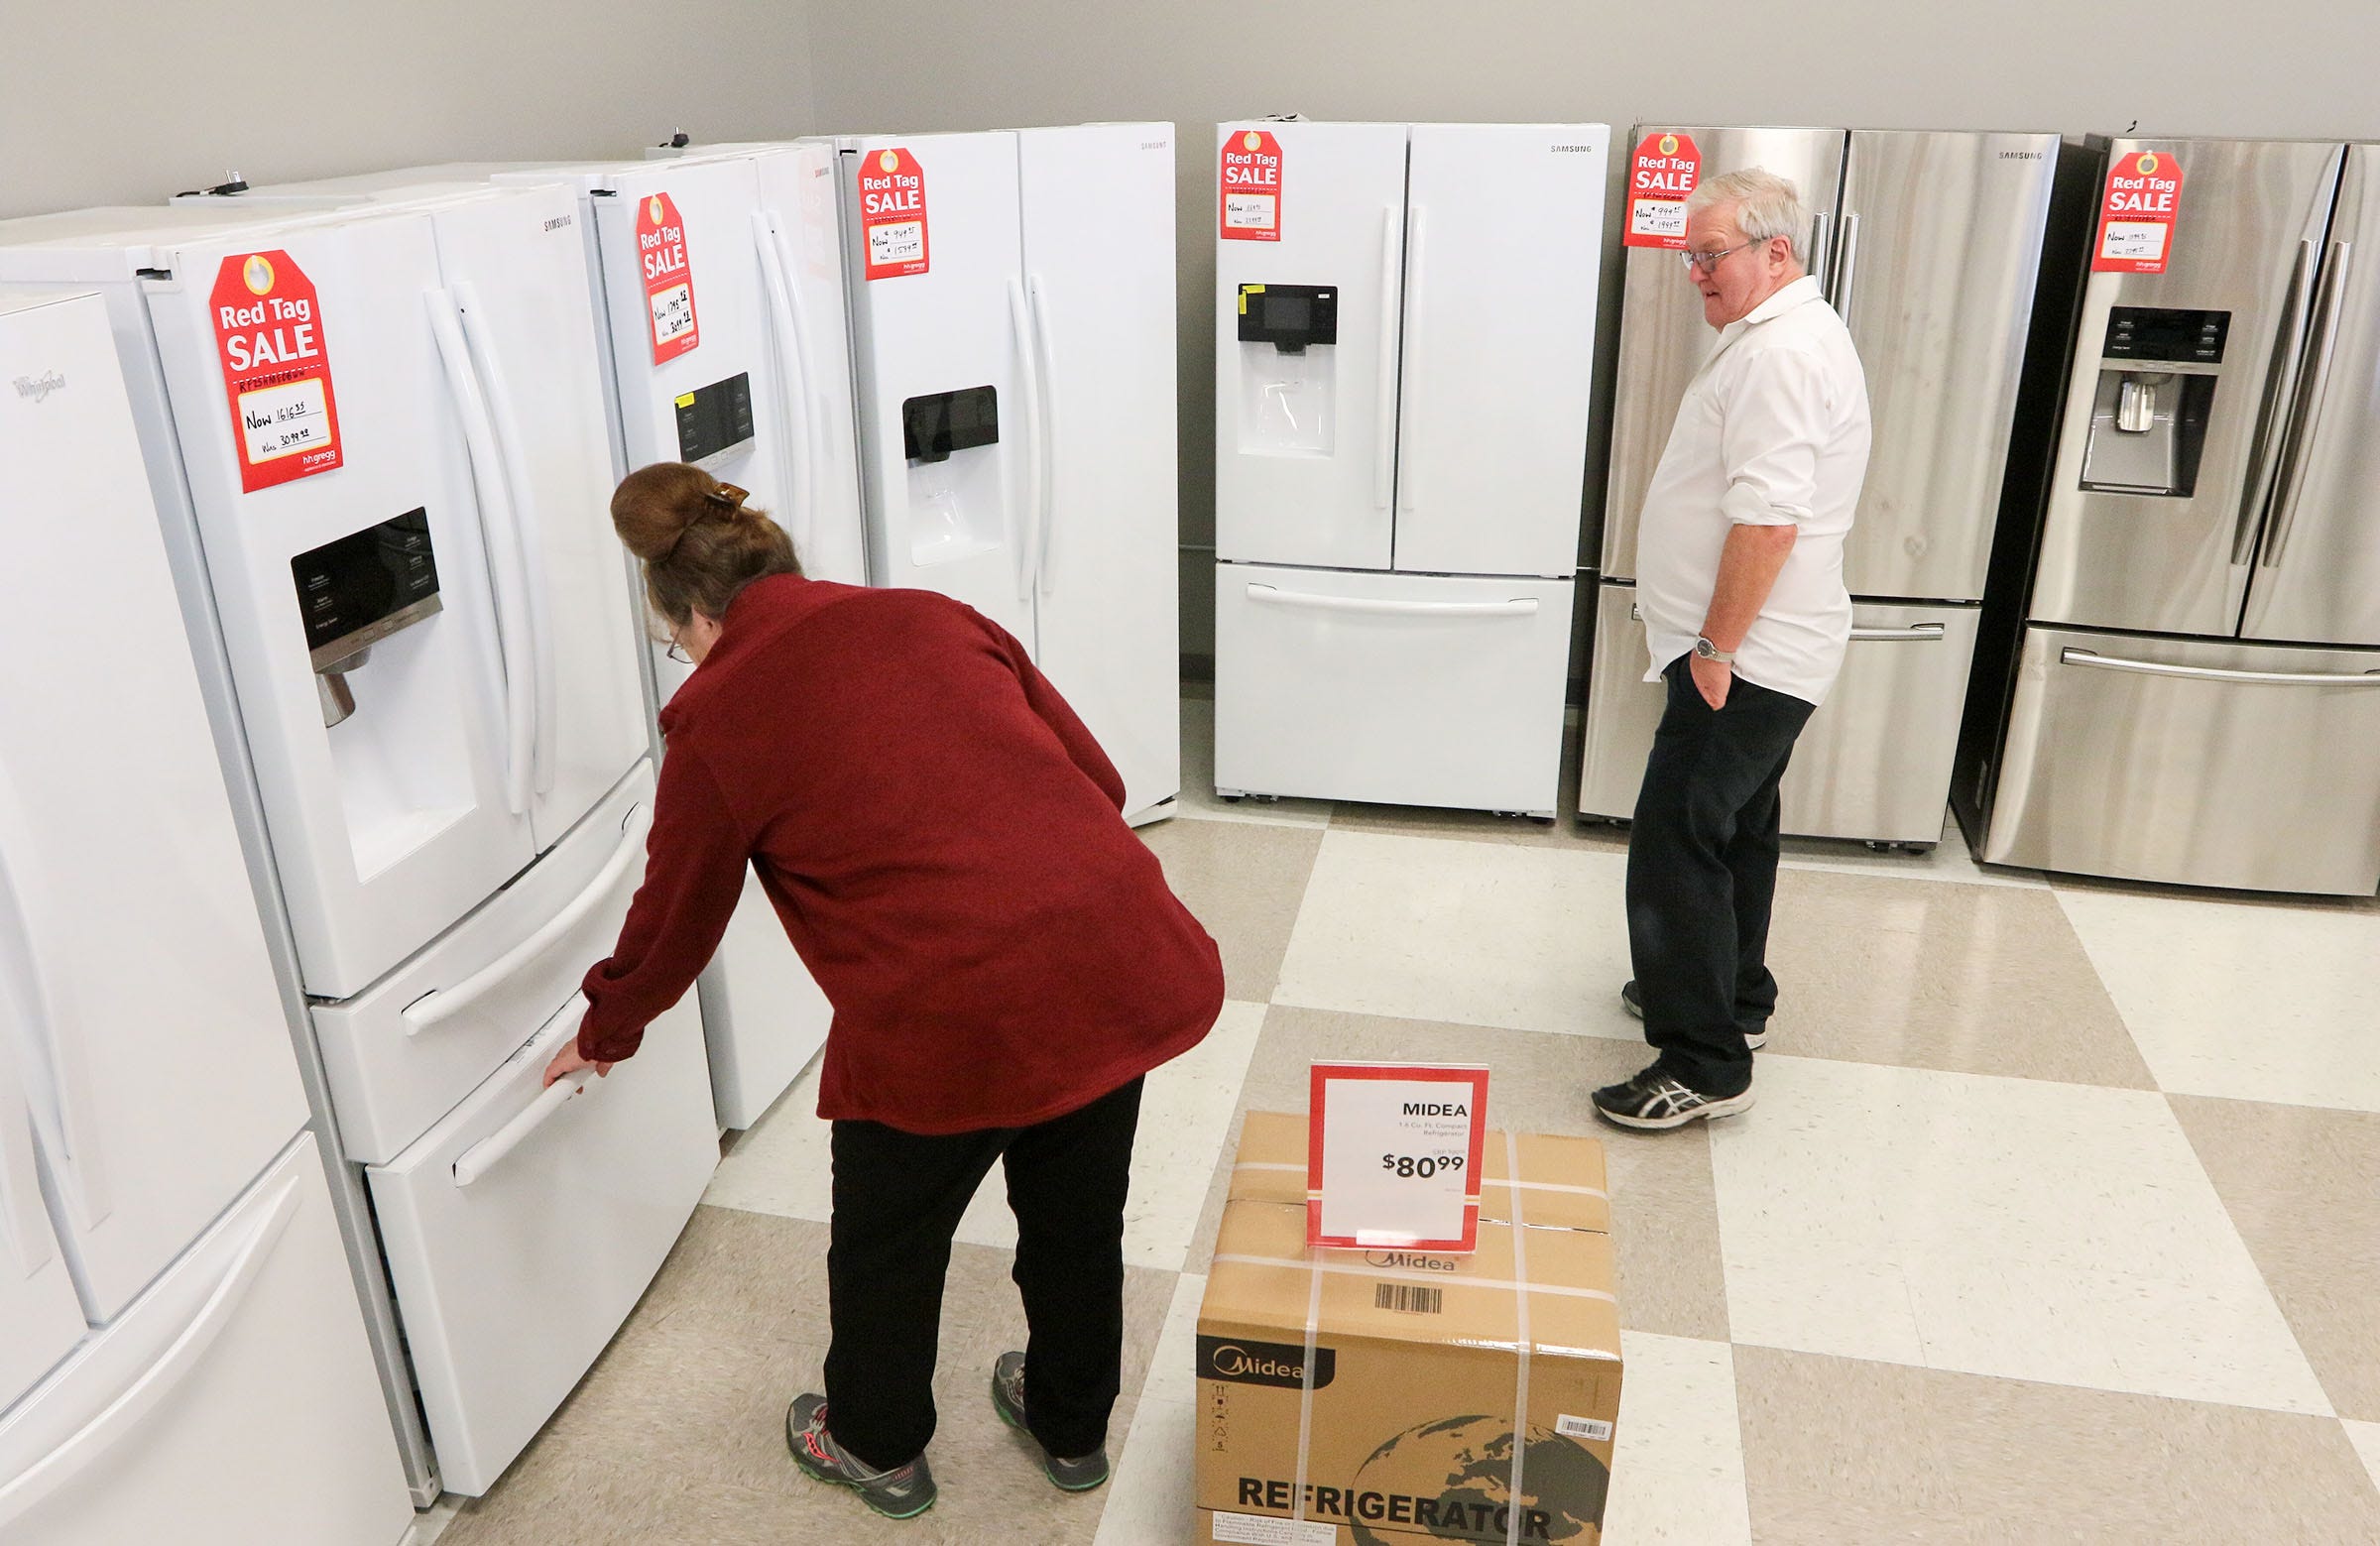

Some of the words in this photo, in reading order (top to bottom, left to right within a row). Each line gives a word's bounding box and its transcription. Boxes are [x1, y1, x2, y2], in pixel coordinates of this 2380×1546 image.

[1226, 152, 1251, 165] Red
[1254, 153, 1277, 168] Tag
[1638, 156, 1667, 170] Red
[1670, 158, 1695, 173] Tag
[864, 176, 891, 191] Red
[893, 175, 919, 188] Tag
[1226, 167, 1277, 185] SALE
[1635, 171, 1693, 191] SALE
[2112, 177, 2144, 189] Red
[2148, 177, 2177, 193] Tag
[865, 190, 921, 214] SALE
[1228, 202, 1243, 212] Now
[2109, 191, 2174, 212] SALE
[1635, 208, 1651, 218] Now
[640, 229, 661, 250] Red
[661, 226, 681, 243] Tag
[873, 235, 889, 247] Now
[2107, 231, 2125, 242] Now
[644, 244, 686, 280] SALE
[219, 300, 265, 330] Red
[269, 297, 311, 322] Tag
[226, 323, 318, 372] SALE
[246, 410, 273, 430] Now
[302, 450, 335, 465] hhgregg
[1403, 1103, 1468, 1118] MIDEA
[1365, 1249, 1456, 1271] Midea
[1213, 1346, 1304, 1379] Midea
[1239, 1478, 1553, 1540] REFRIGERATOR
